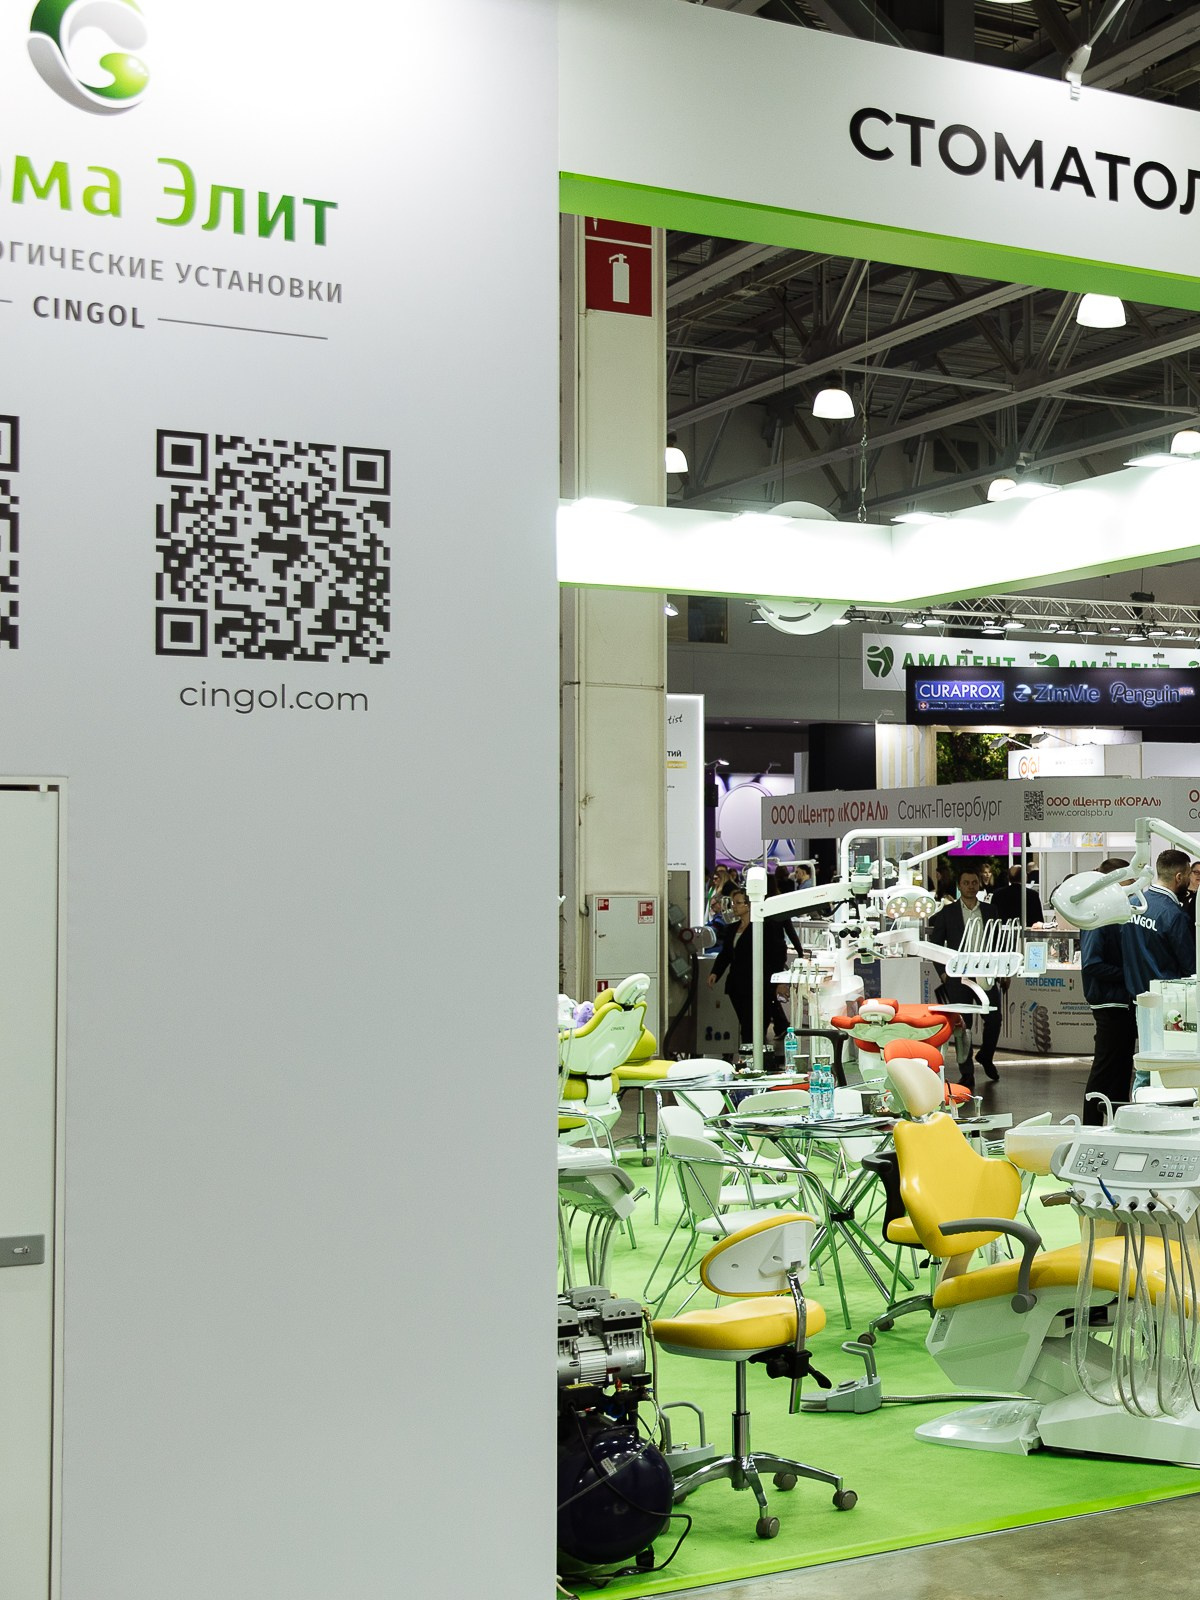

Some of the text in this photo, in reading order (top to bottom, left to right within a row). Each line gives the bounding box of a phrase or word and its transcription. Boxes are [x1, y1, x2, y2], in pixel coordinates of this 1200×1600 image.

[0, 154, 339, 247] ма Элит
[175, 262, 343, 304] УСТАНОВКИ
[33, 295, 146, 329] CINGOL
[179, 680, 369, 714] cingol.com
[919, 684, 1001, 698] CURAPROX
[1034, 684, 1100, 703] ZimVie
[1109, 681, 1180, 707] Penguin
[771, 796, 1003, 828] ООО «Центр «КОРАЛ» Санкт-Петербург
[1046, 796, 1162, 809] ООО «Центр «КОРАЛ»
[1046, 808, 1114, 818] www.coralspb.ru
[1038, 977, 1066, 988] DENTAL
